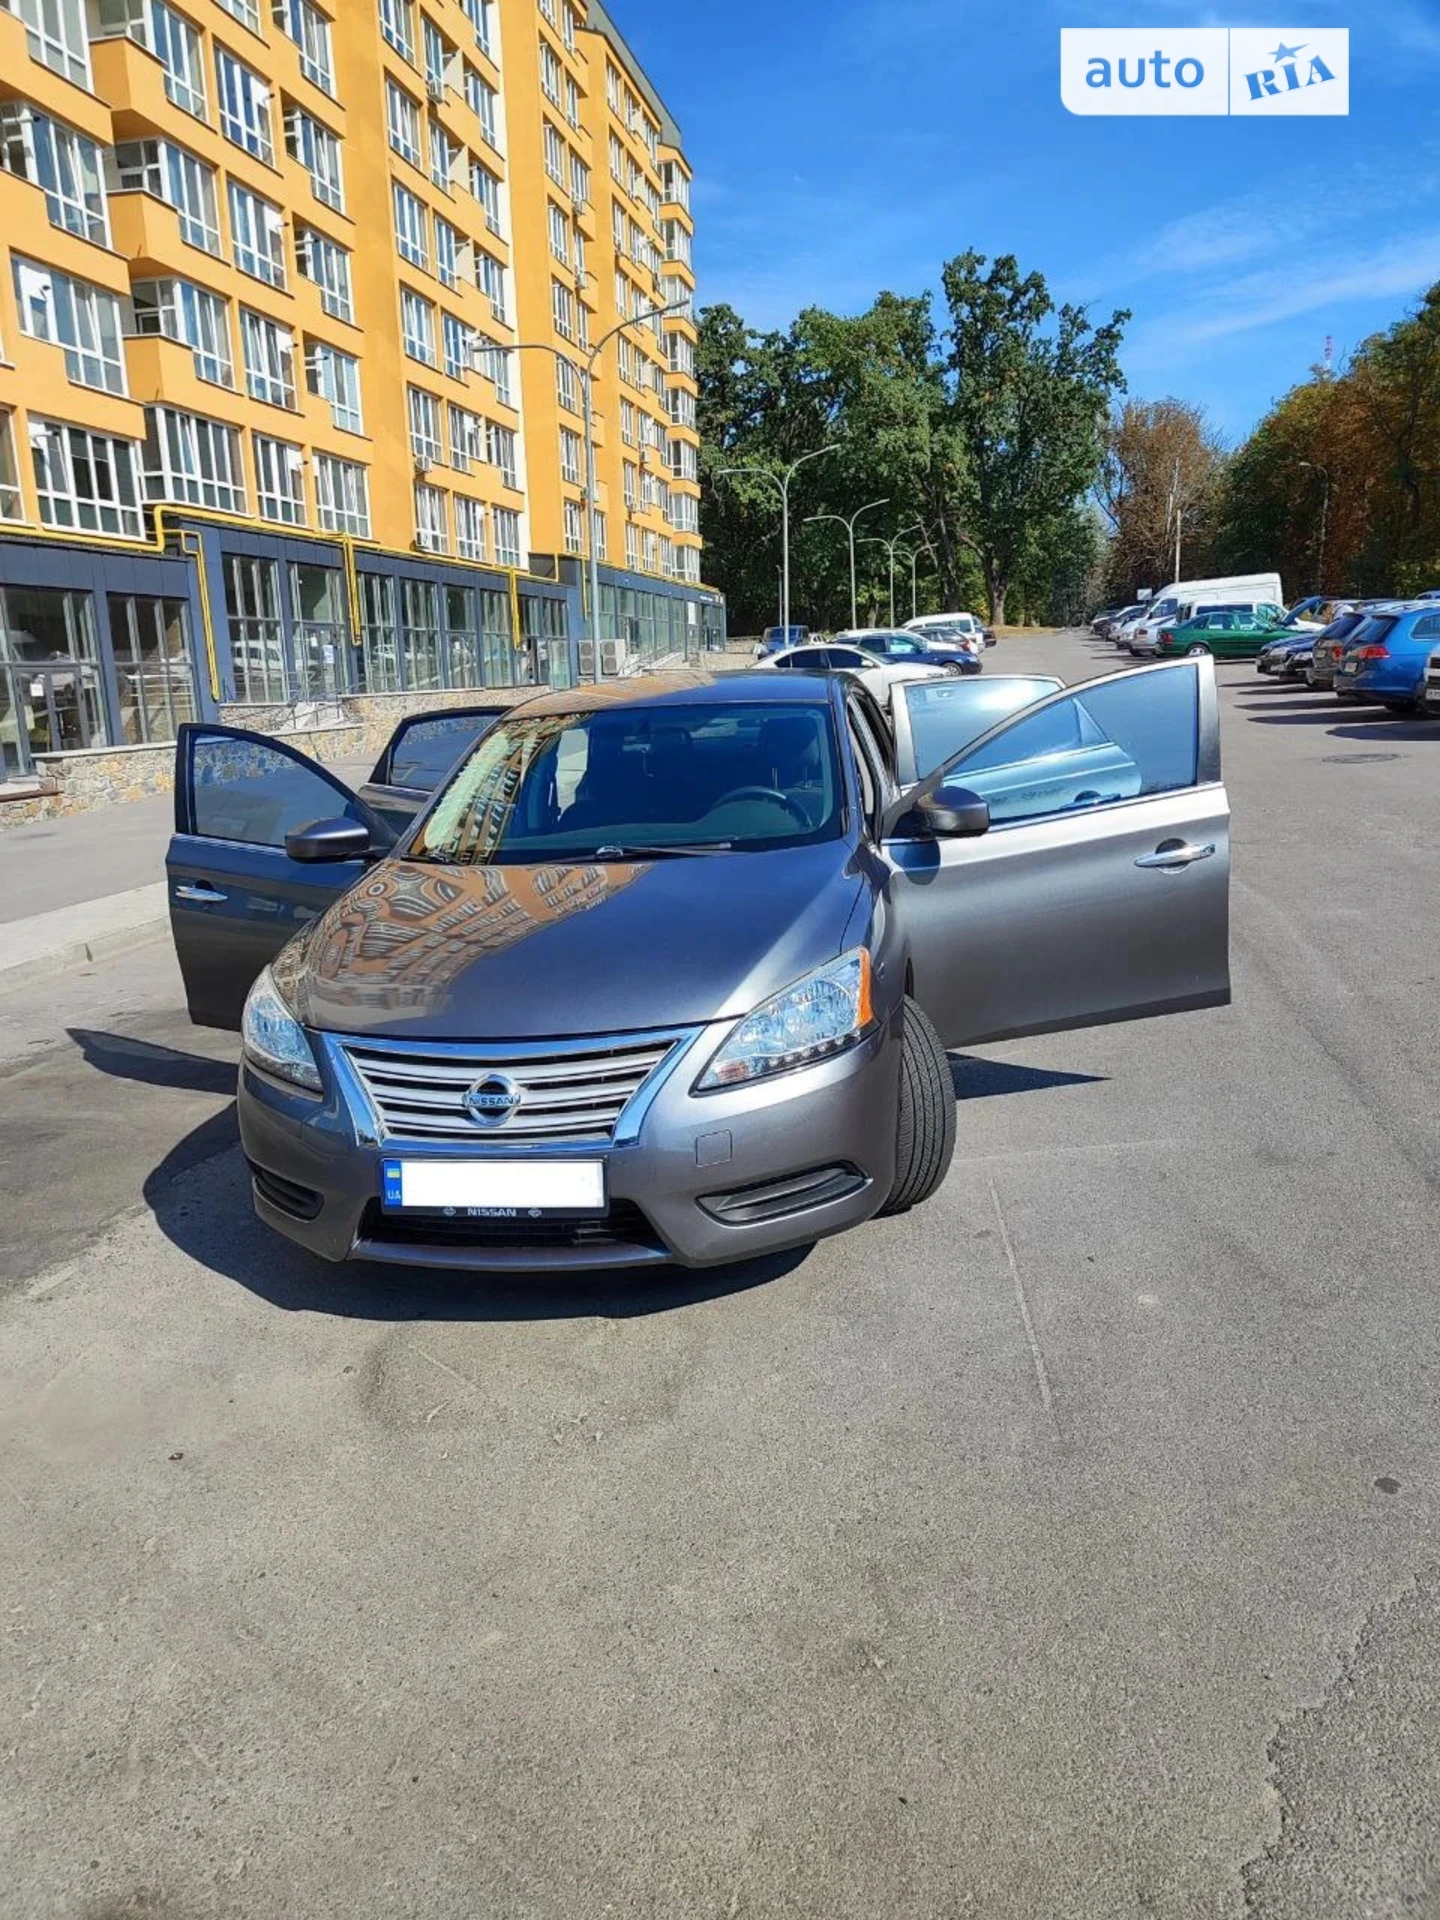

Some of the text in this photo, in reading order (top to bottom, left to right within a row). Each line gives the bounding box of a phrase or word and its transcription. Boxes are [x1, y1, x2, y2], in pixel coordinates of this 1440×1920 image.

[468, 1097, 515, 1106] NISSAN
[387, 1189, 401, 1199] UA
[467, 1207, 517, 1217] NISSAN
